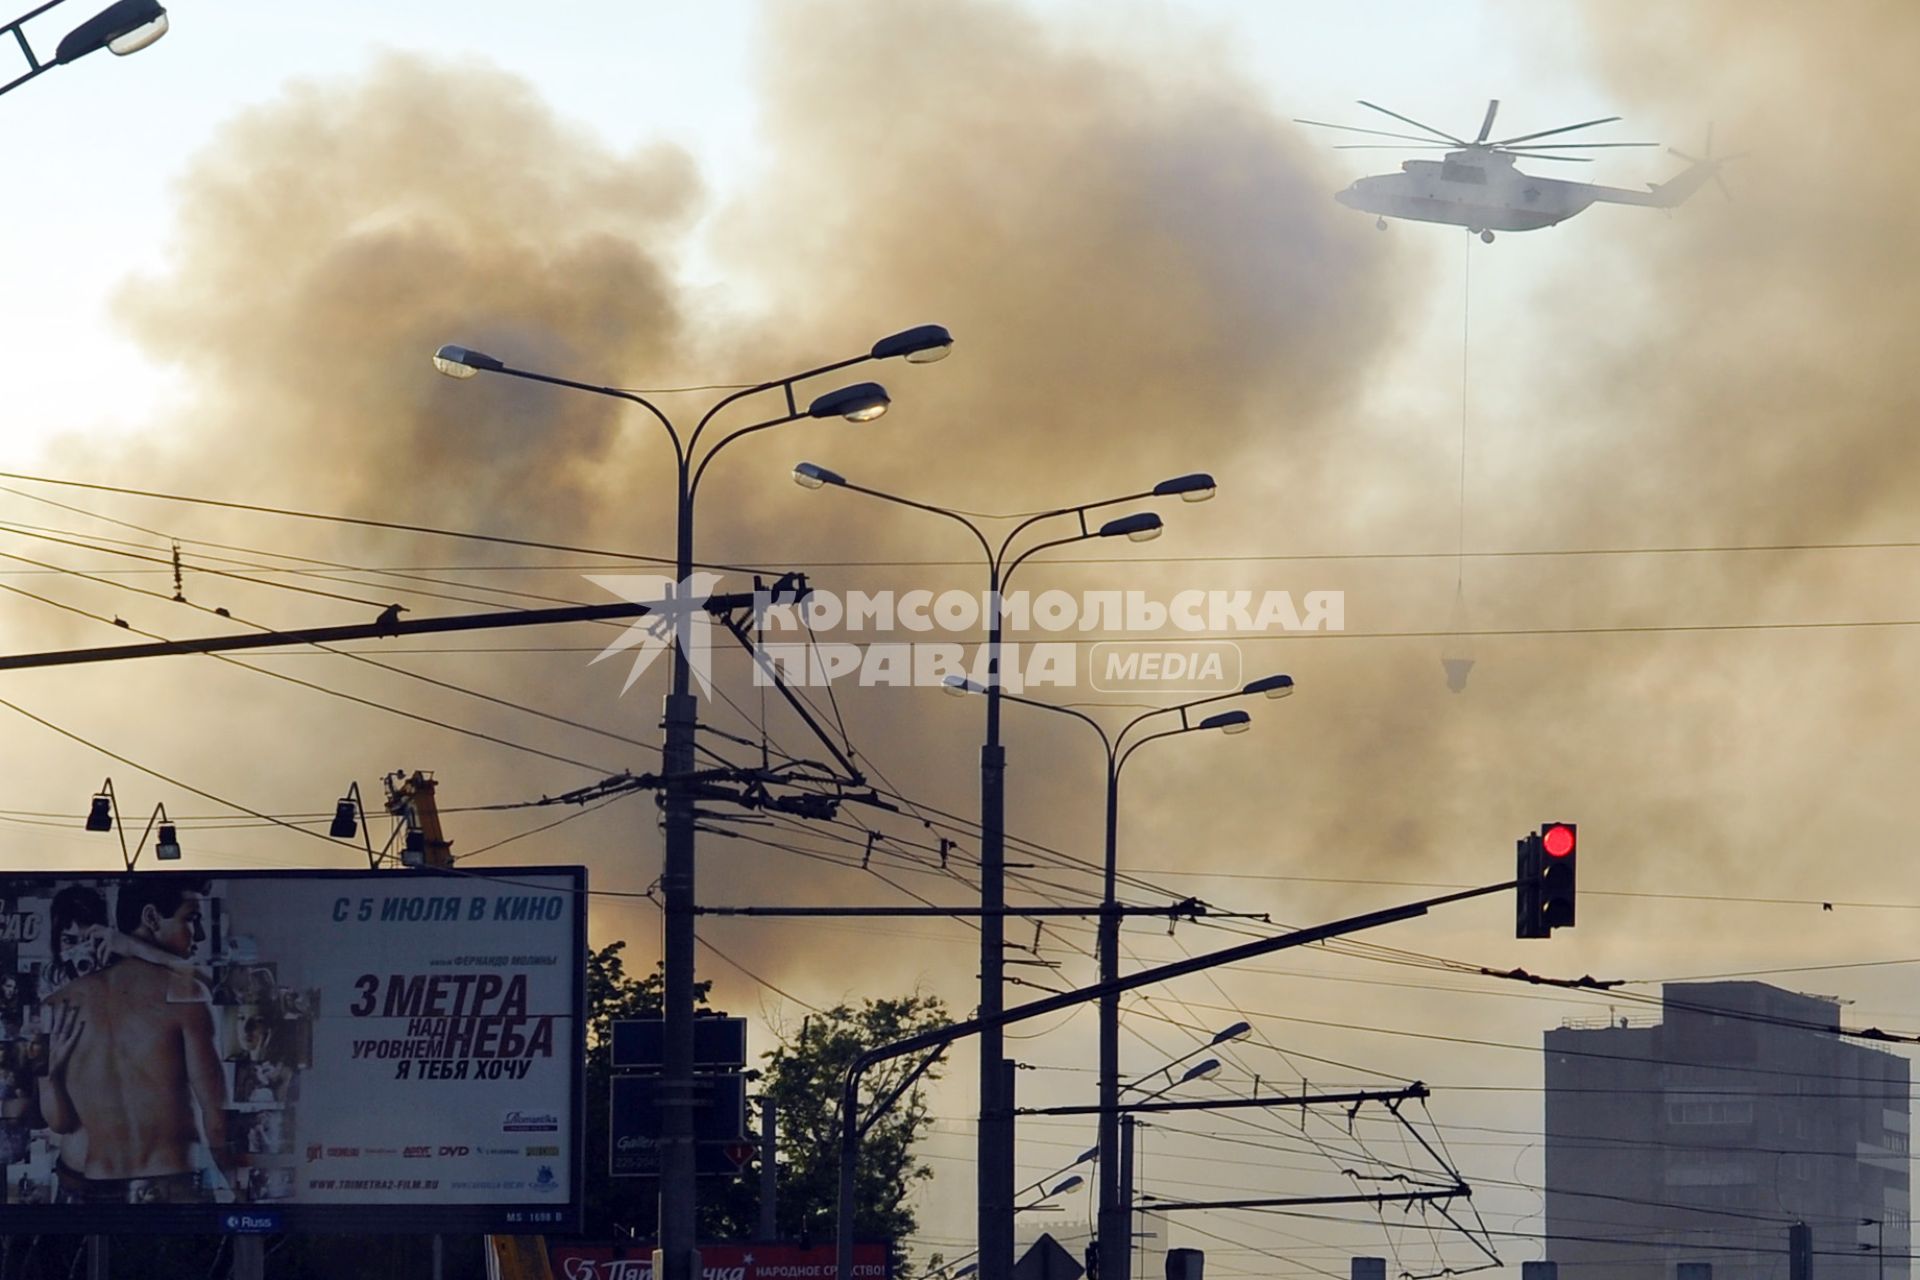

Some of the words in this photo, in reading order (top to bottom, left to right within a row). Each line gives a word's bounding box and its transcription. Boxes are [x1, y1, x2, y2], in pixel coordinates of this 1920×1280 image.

[332, 897, 350, 921] С
[357, 898, 374, 921] 5
[380, 897, 462, 921] ИЮЛЯ
[468, 897, 486, 920] В
[493, 896, 564, 920] КИНО
[454, 956, 508, 967] ФЕРНАНДО
[350, 974, 380, 1017] 3
[382, 974, 527, 1017] МЕТРА
[407, 1018, 445, 1039] НАД
[443, 1016, 554, 1058] НЕБА
[351, 1040, 444, 1059] УРОВНЕМ
[394, 1060, 412, 1079] Я
[417, 1060, 469, 1079] ТЕБЯ
[474, 1060, 533, 1079] ХОЧУ
[438, 1147, 469, 1156] DVD
[241, 1216, 272, 1228] Russ
[756, 1265, 820, 1277] НАРОДНОЕ
[824, 1265, 885, 1277] СРСТВО!
